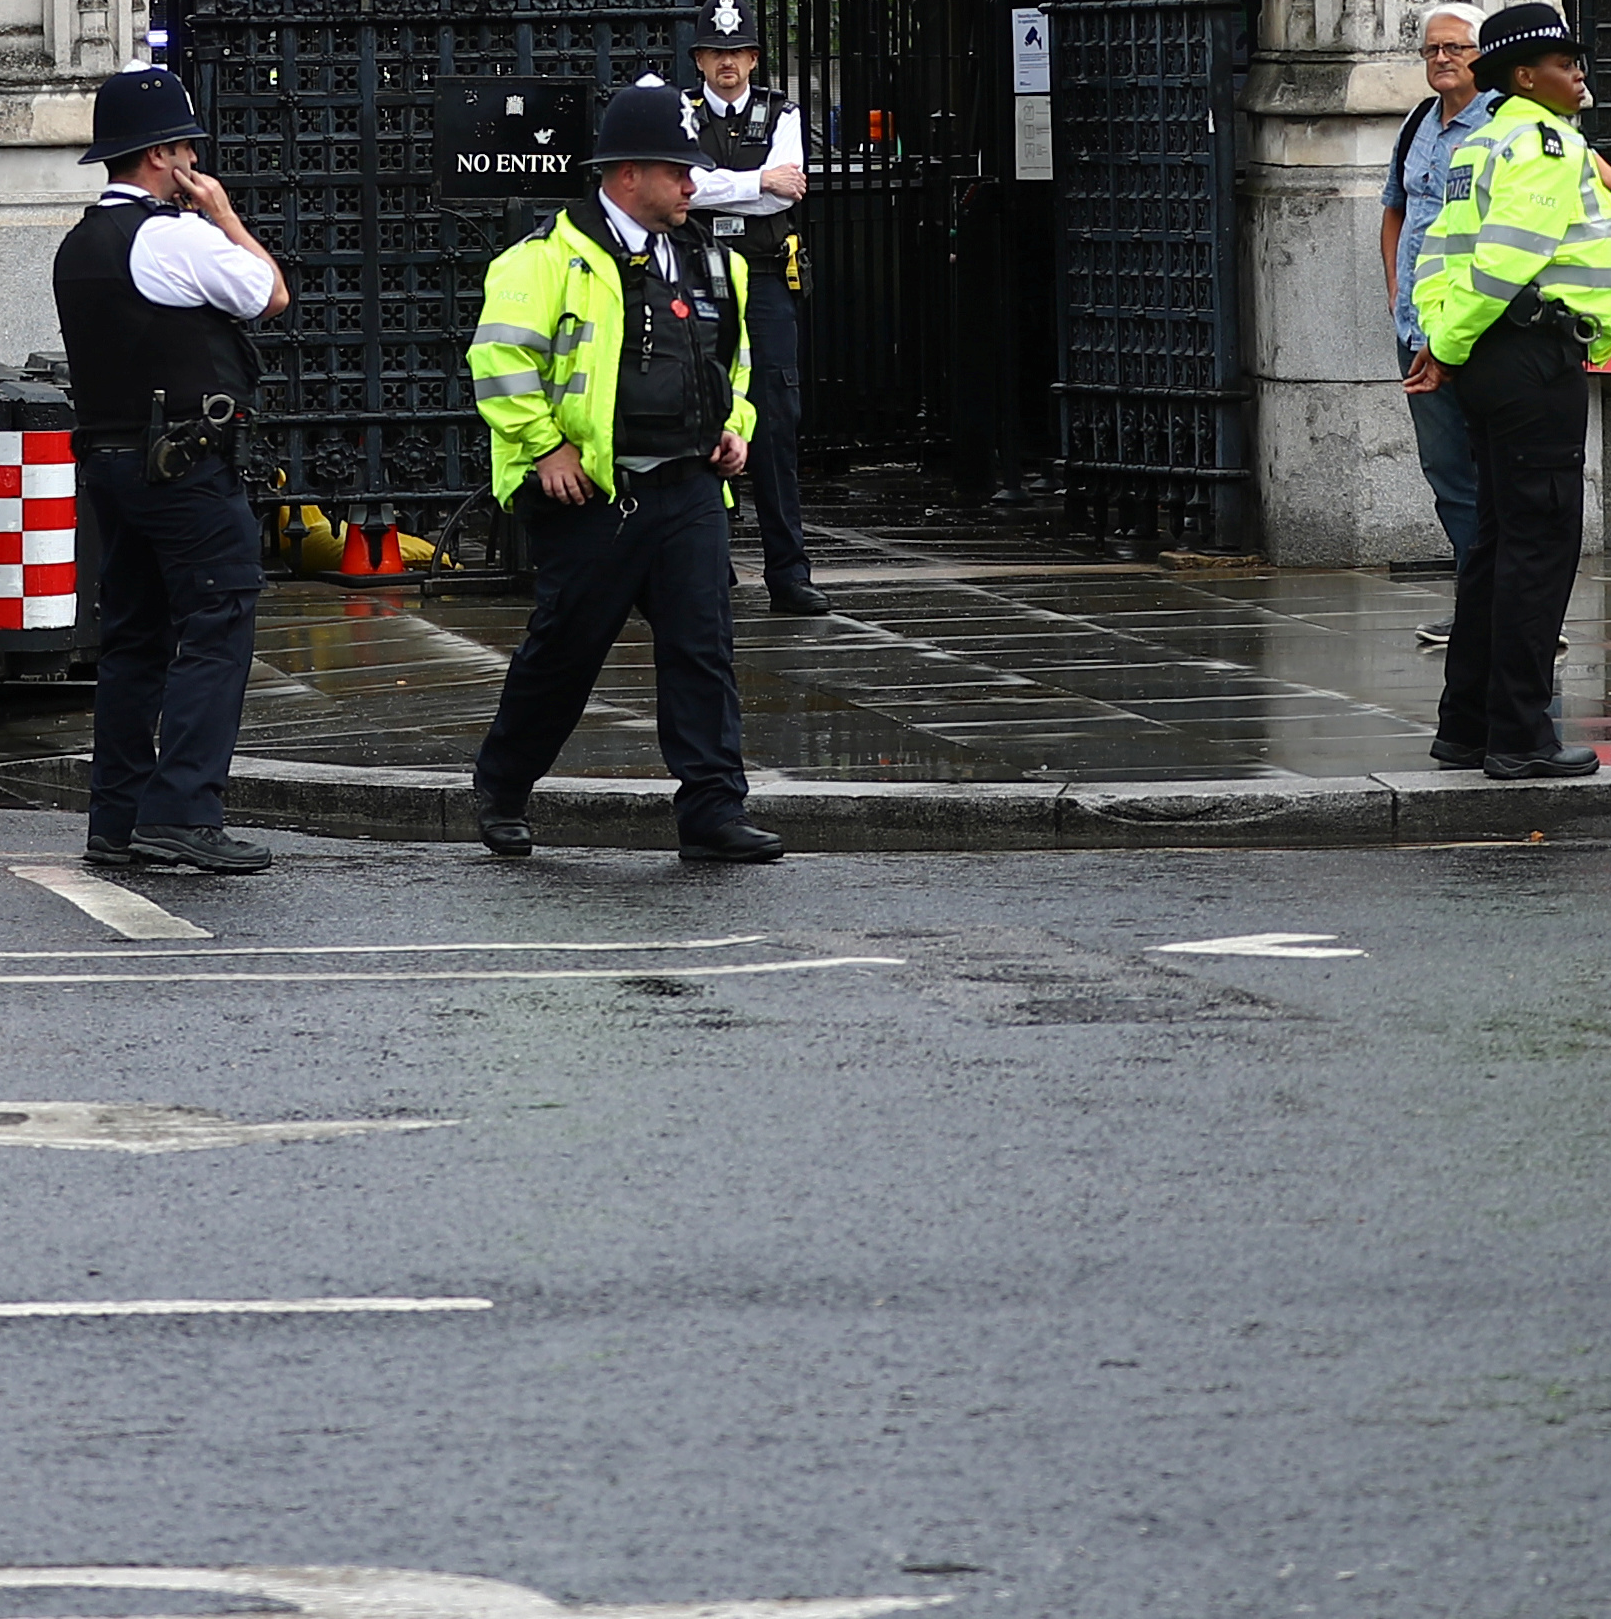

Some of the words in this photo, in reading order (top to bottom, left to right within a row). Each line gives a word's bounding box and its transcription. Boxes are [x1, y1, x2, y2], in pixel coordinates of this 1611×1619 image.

[456, 153, 490, 173] NO
[496, 153, 572, 173] ENTRY
[1529, 193, 1556, 208] POLICE
